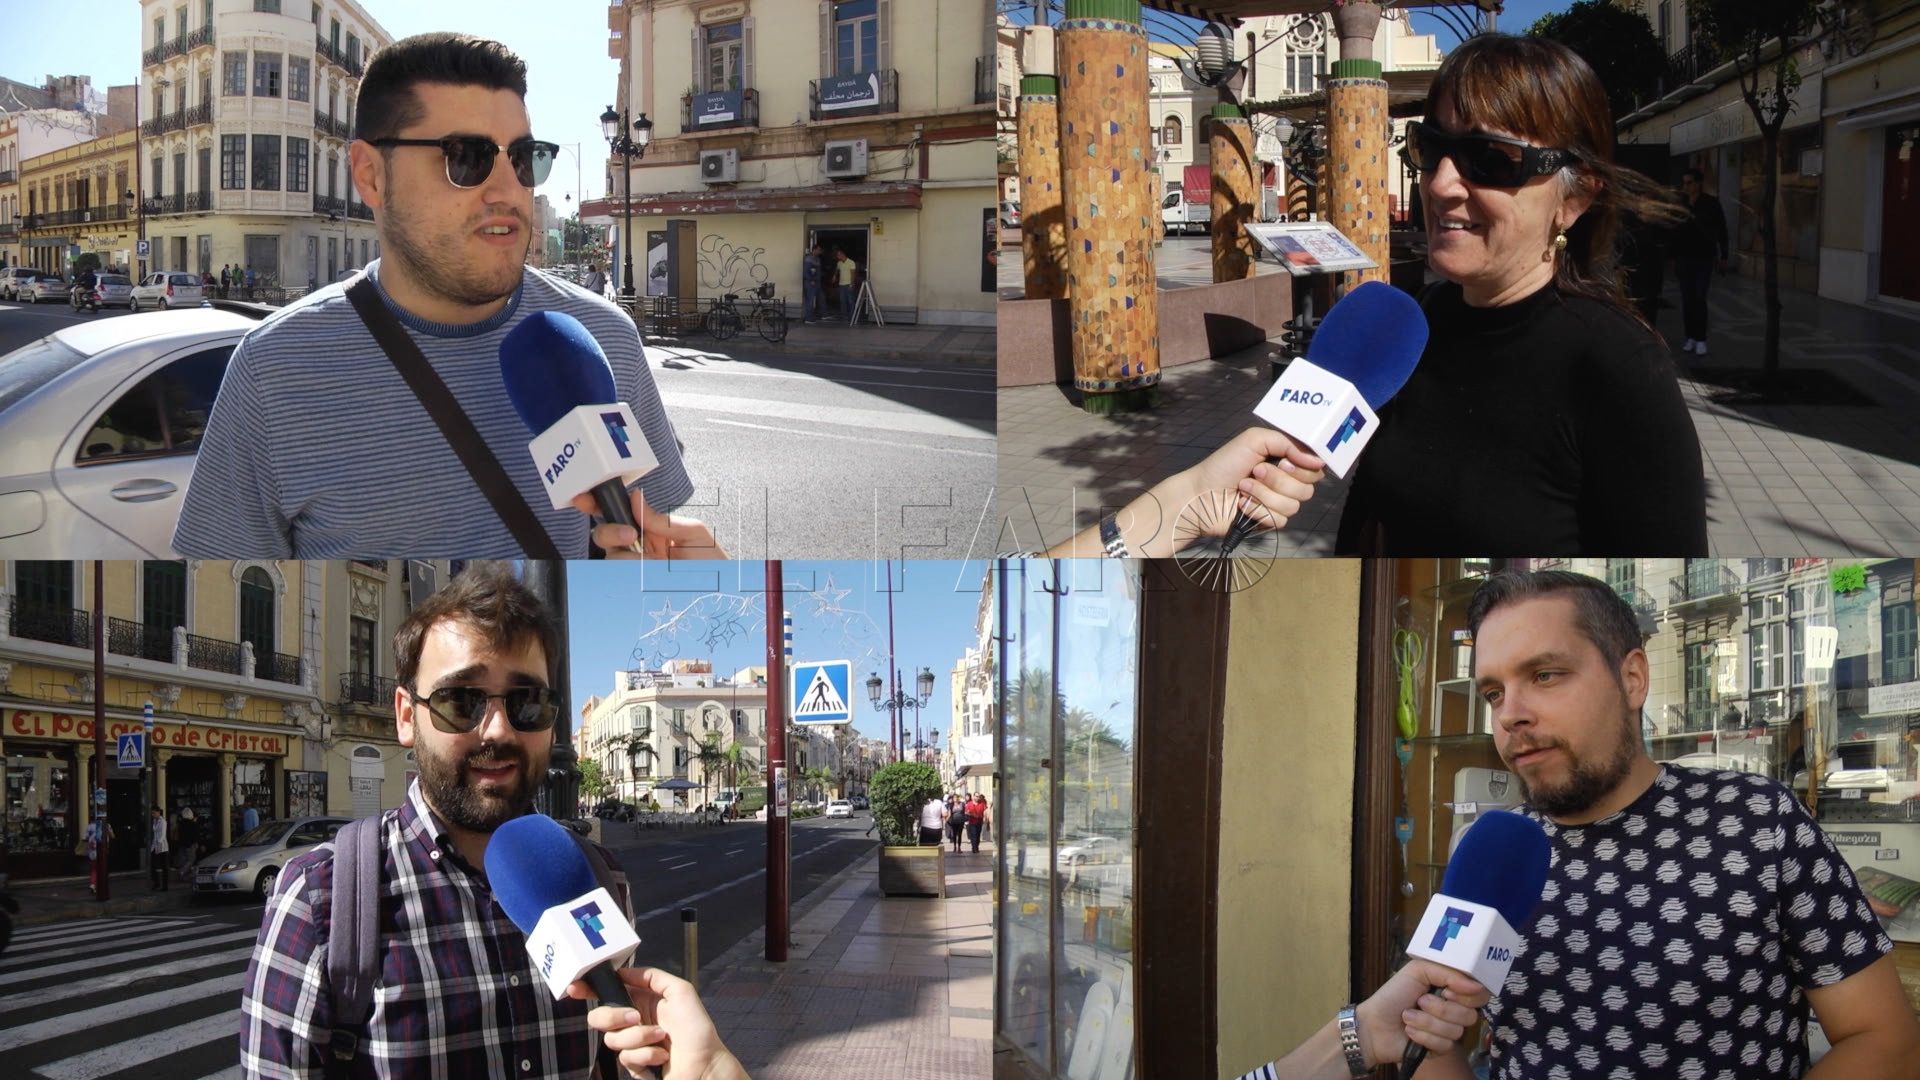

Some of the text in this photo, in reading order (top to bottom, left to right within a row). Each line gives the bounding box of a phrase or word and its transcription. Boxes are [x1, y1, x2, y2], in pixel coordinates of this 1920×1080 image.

[1279, 388, 1324, 406] FARO
[544, 443, 575, 485] FARO
[172, 724, 201, 746] de
[1486, 946, 1510, 962] FARO
